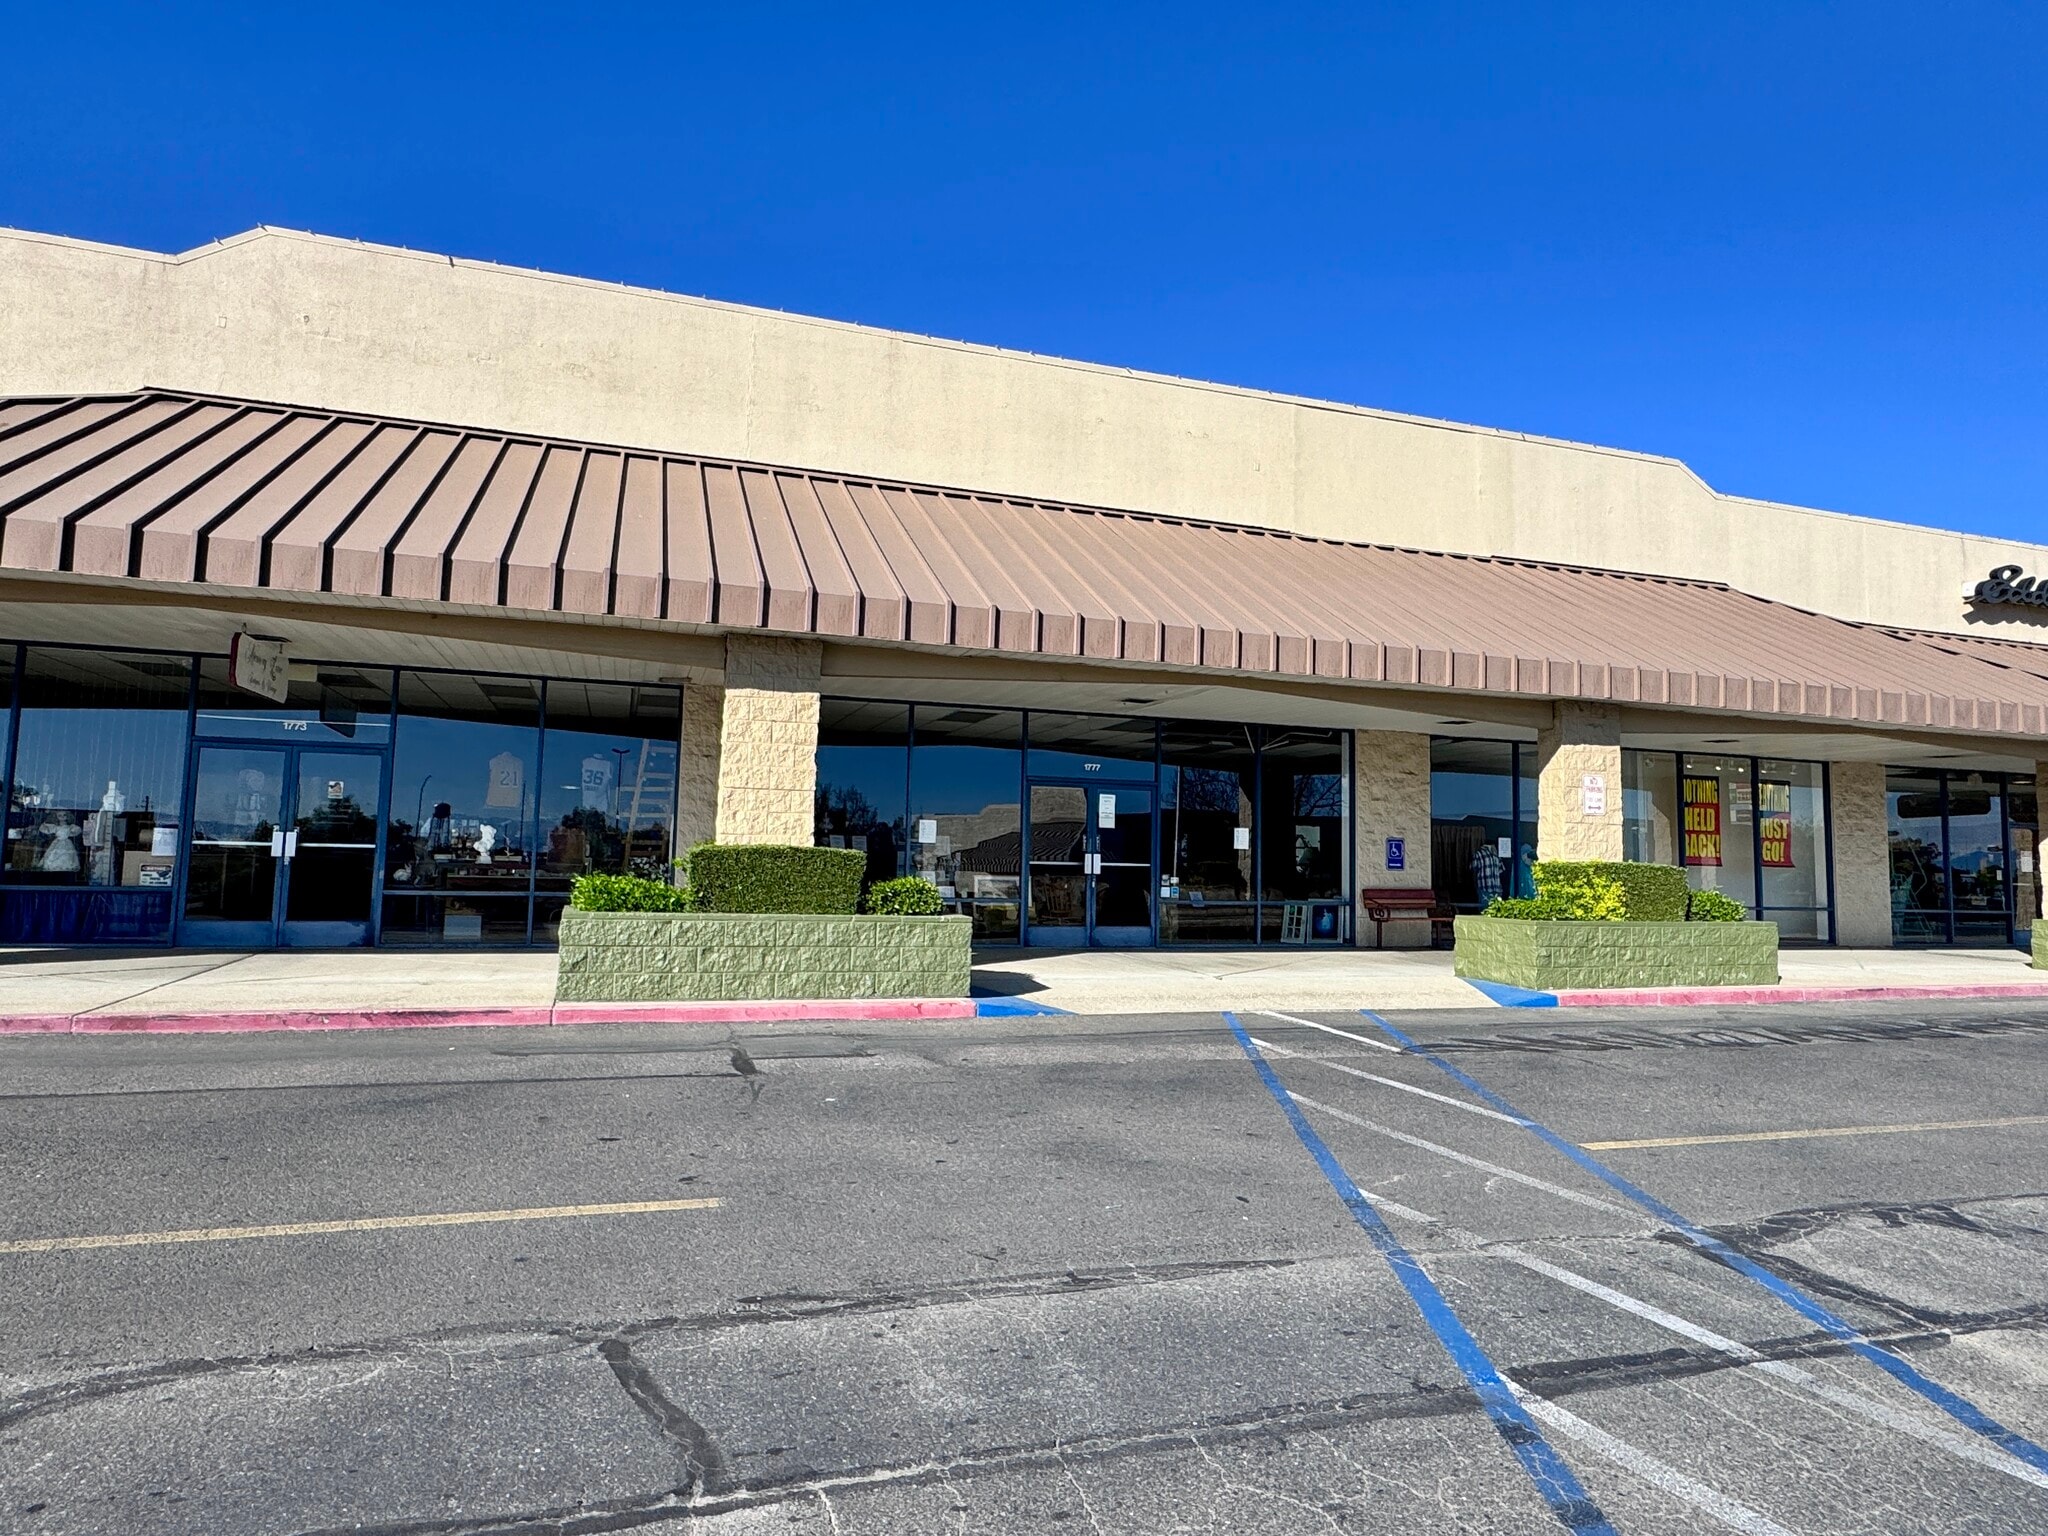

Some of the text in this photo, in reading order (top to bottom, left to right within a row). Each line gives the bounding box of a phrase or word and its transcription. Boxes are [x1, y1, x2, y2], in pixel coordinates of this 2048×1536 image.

[283, 722, 307, 731] 1773
[1084, 763, 1101, 771] 1777
[501, 770, 518, 786] 21
[583, 769, 604, 785] 36
[1684, 807, 1715, 831] HELD
[1762, 841, 1785, 862] GO!
